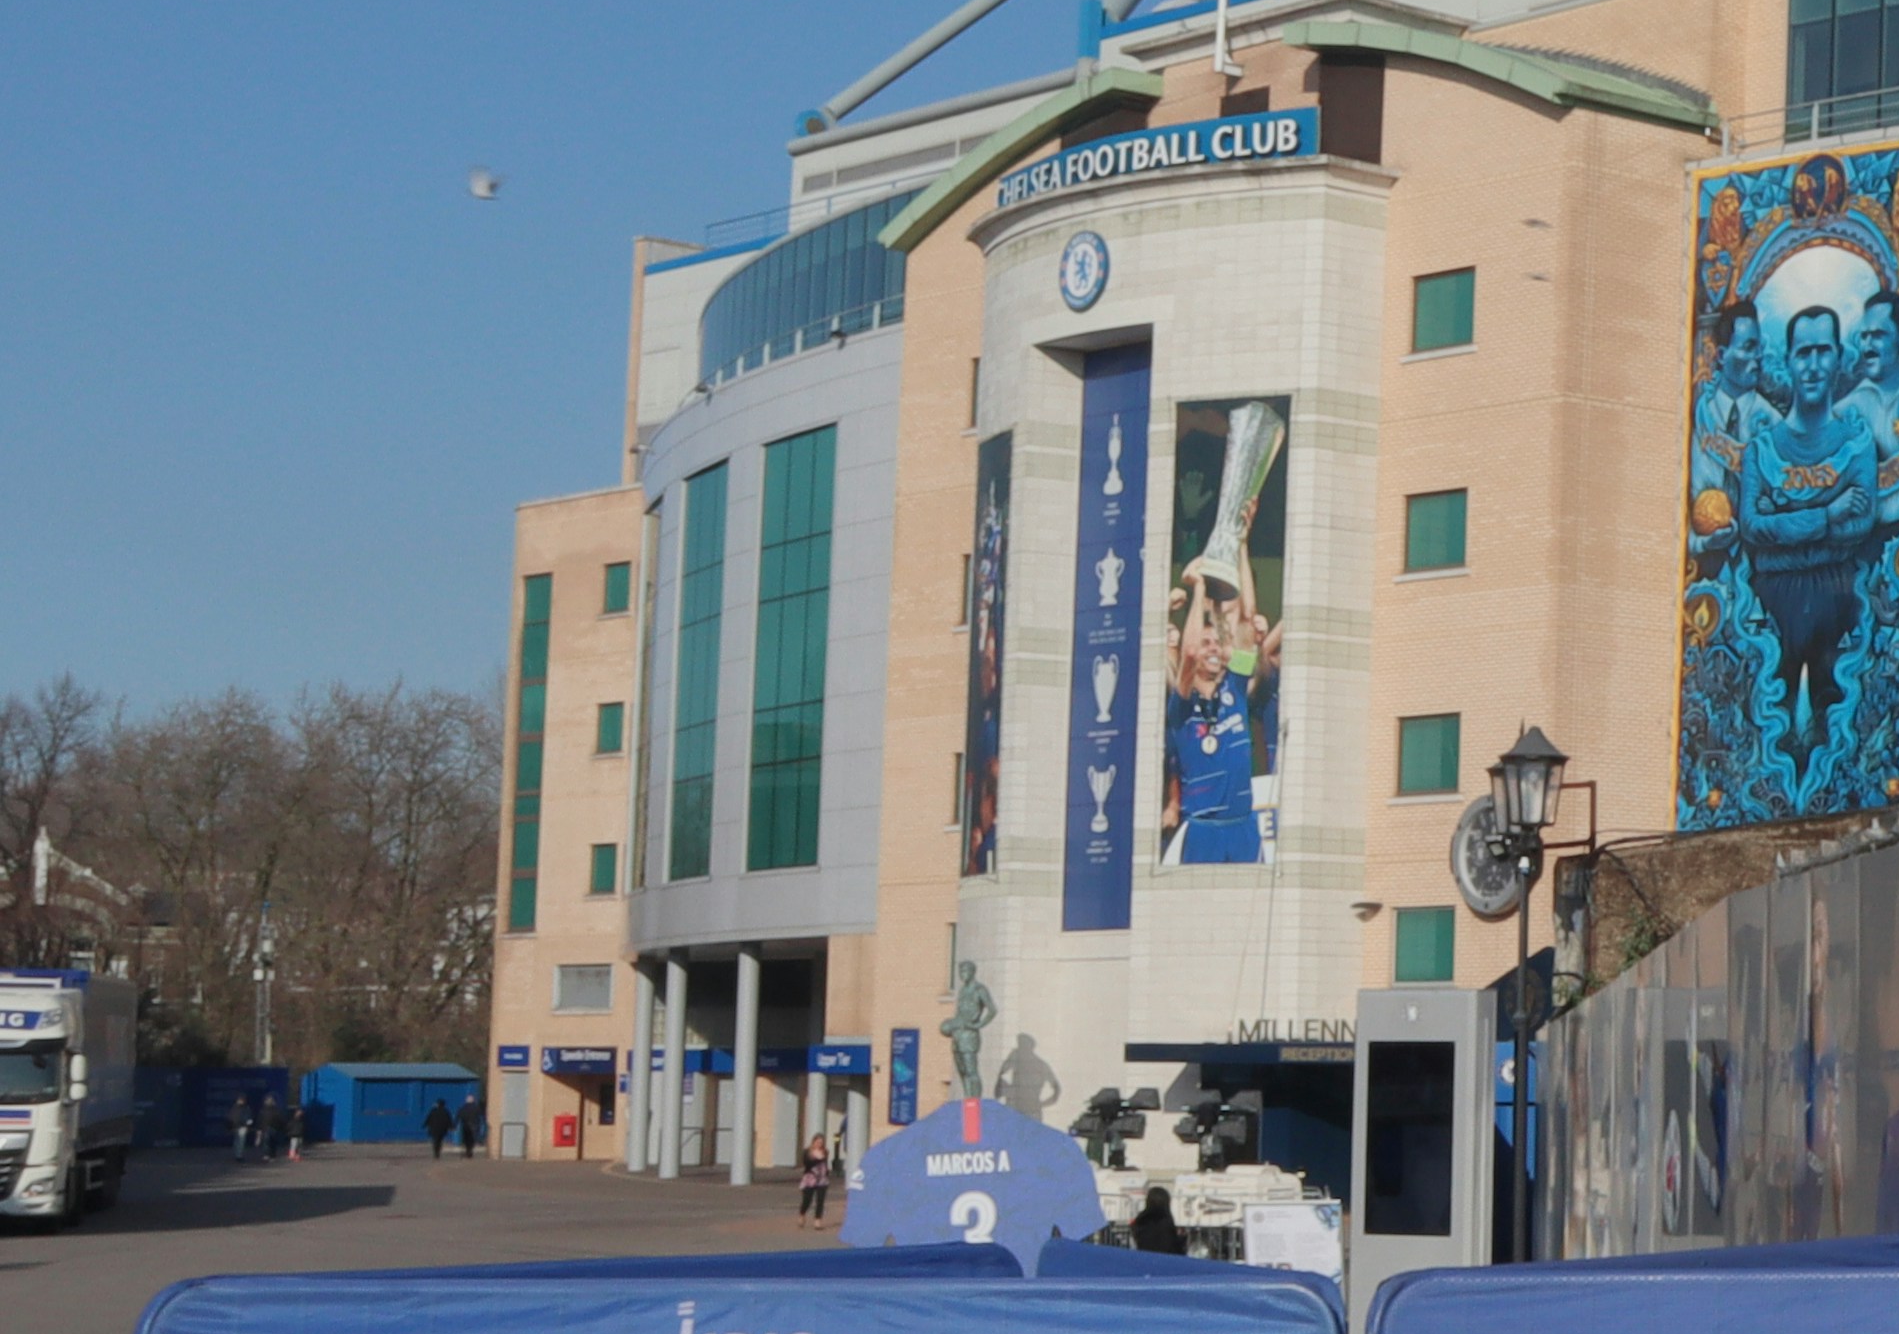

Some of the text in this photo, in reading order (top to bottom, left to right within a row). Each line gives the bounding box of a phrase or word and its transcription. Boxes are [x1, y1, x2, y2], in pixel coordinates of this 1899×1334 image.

[1065, 129, 1205, 186] FOOTBALL
[1211, 118, 1298, 159] CLUB
[926, 1150, 1010, 1177] MARCOS A
